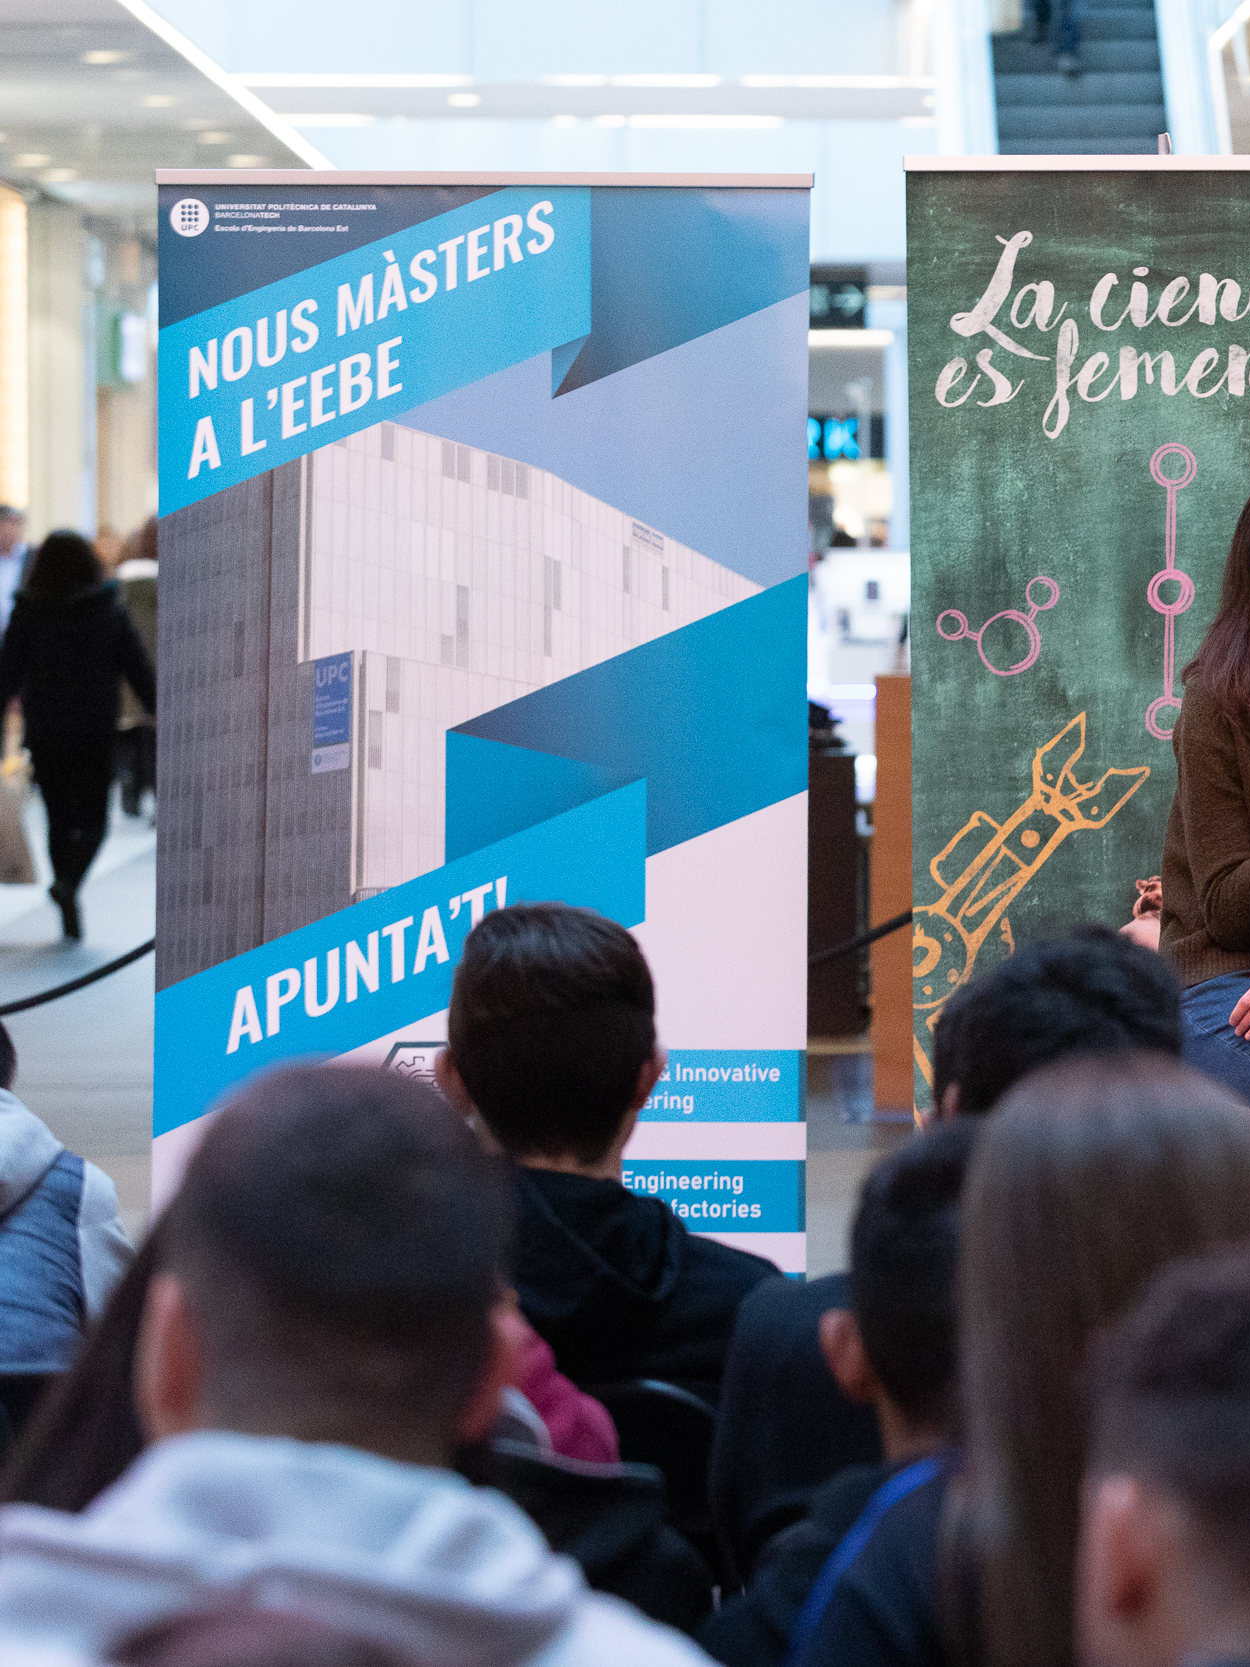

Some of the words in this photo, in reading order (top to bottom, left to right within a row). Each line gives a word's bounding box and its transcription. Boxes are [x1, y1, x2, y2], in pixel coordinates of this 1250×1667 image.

[267, 202, 319, 210] POLITÈCNICA
[241, 224, 286, 233] d'Enginyeria
[189, 299, 320, 398] NOUS
[336, 199, 556, 337] MÀSTERS
[949, 231, 1068, 360] La
[934, 349, 1024, 408] es
[187, 416, 222, 480] A
[240, 336, 403, 457] L'EEBE
[316, 662, 349, 687] UPC
[676, 1062, 781, 1082] Innovative
[622, 1171, 744, 1194] Engineering
[671, 1198, 762, 1218] factories
